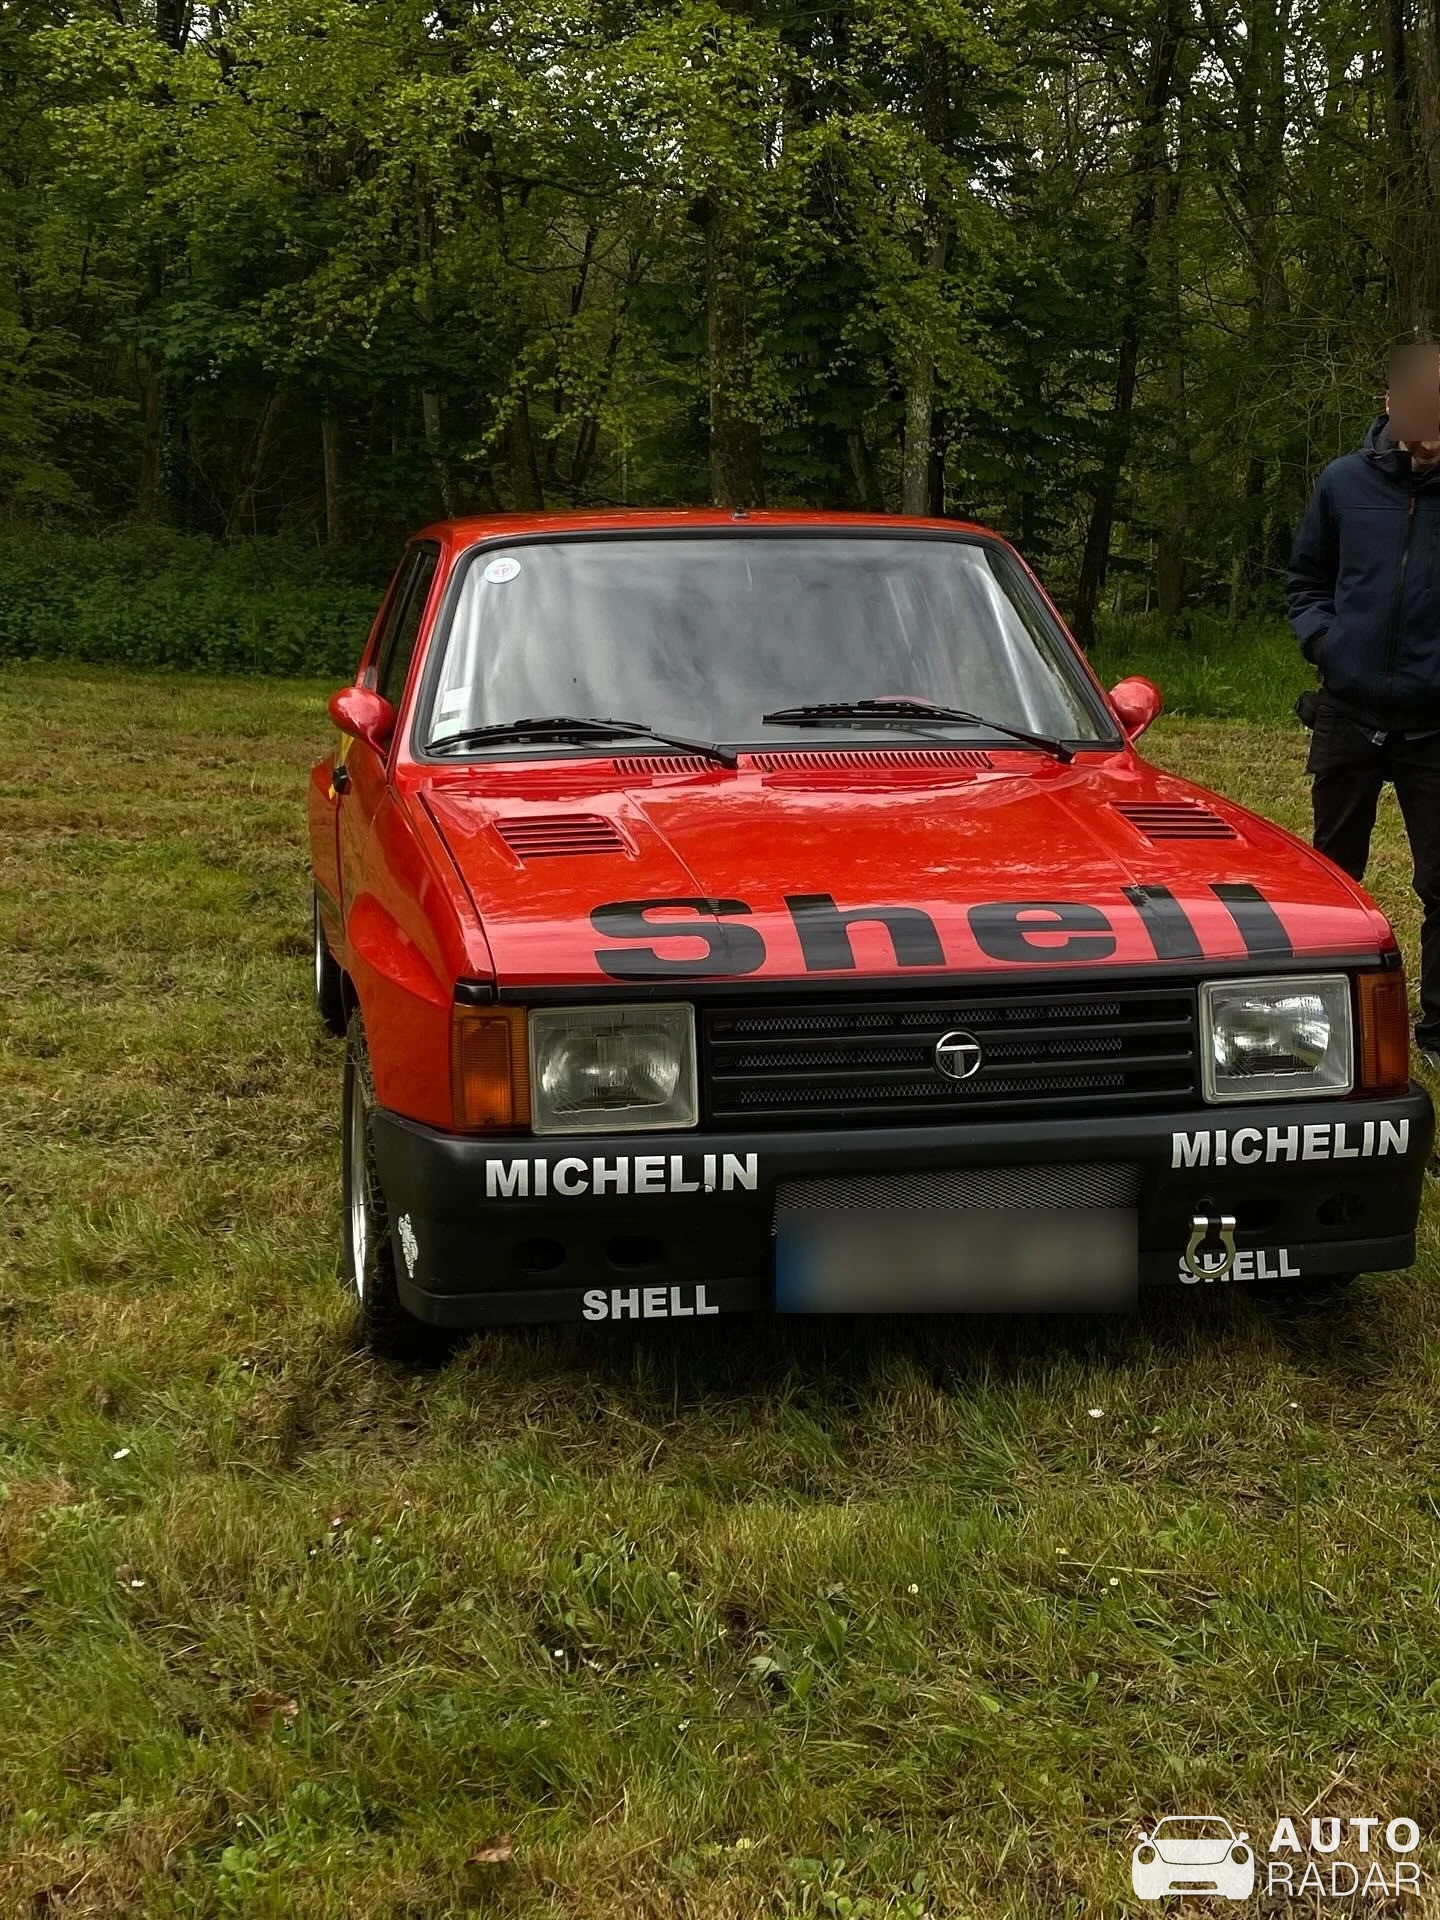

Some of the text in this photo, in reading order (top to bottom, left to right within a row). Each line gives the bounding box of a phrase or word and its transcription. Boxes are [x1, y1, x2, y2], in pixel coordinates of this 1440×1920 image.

[589, 883, 1294, 983] shell
[1171, 1119, 1410, 1169] MICHELIN
[485, 1153, 758, 1197] MICHELIN
[582, 1284, 720, 1321] SHELL
